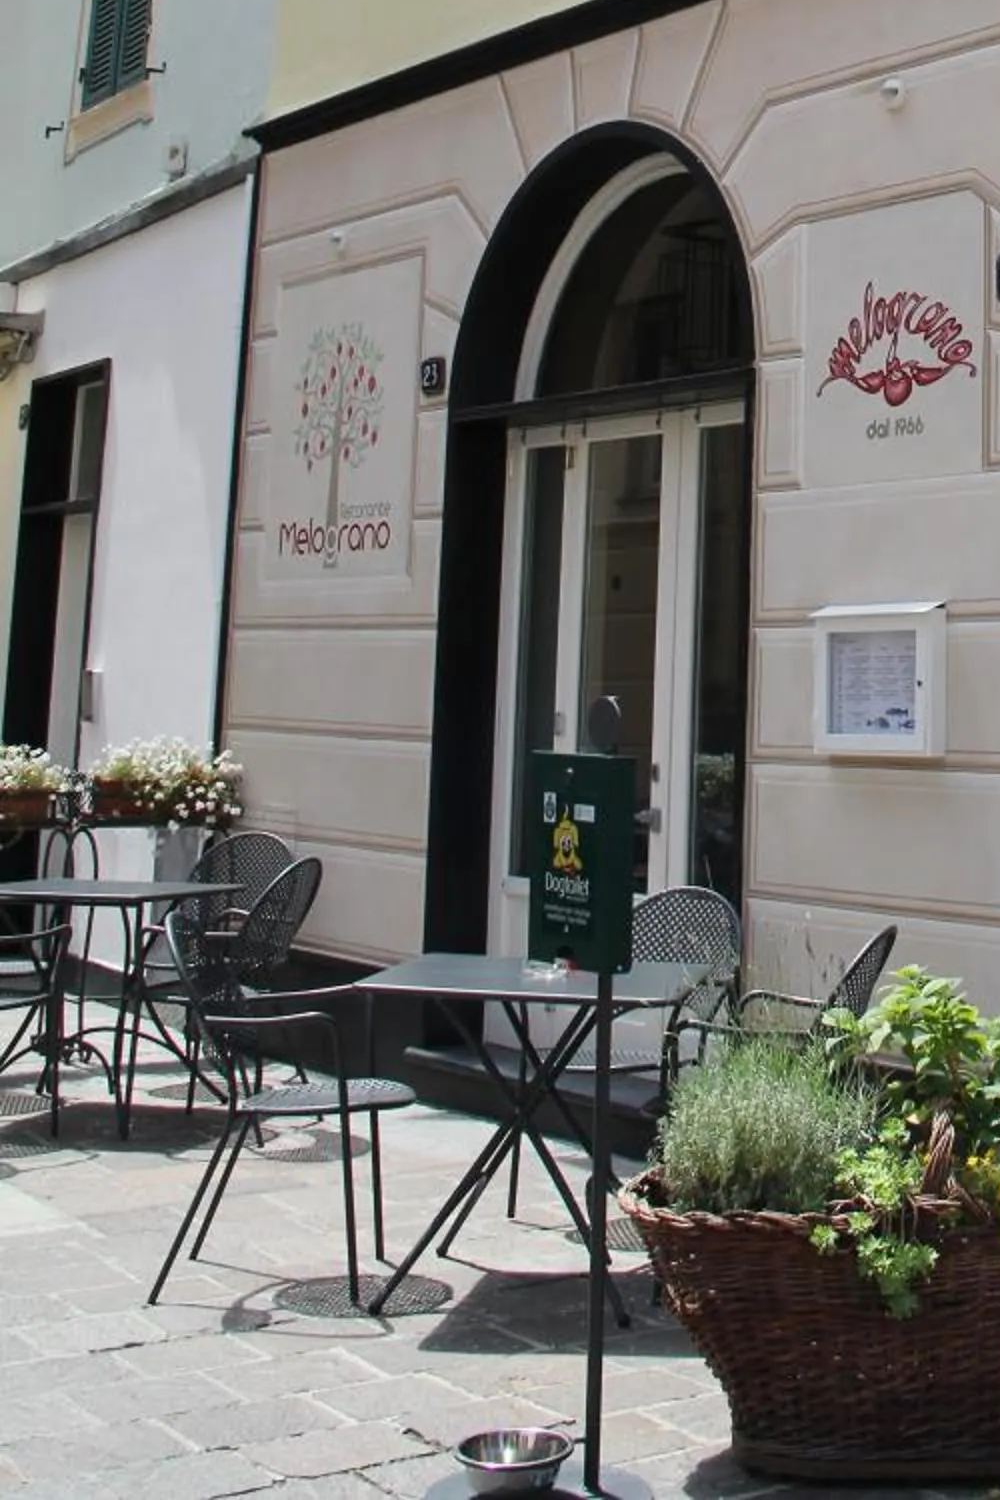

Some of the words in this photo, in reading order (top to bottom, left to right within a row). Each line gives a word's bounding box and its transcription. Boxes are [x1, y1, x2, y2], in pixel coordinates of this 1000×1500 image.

[423, 363, 438, 386] 23
[866, 417, 890, 440] dal
[895, 414, 925, 437] 1966
[279, 517, 391, 566] Melograno
